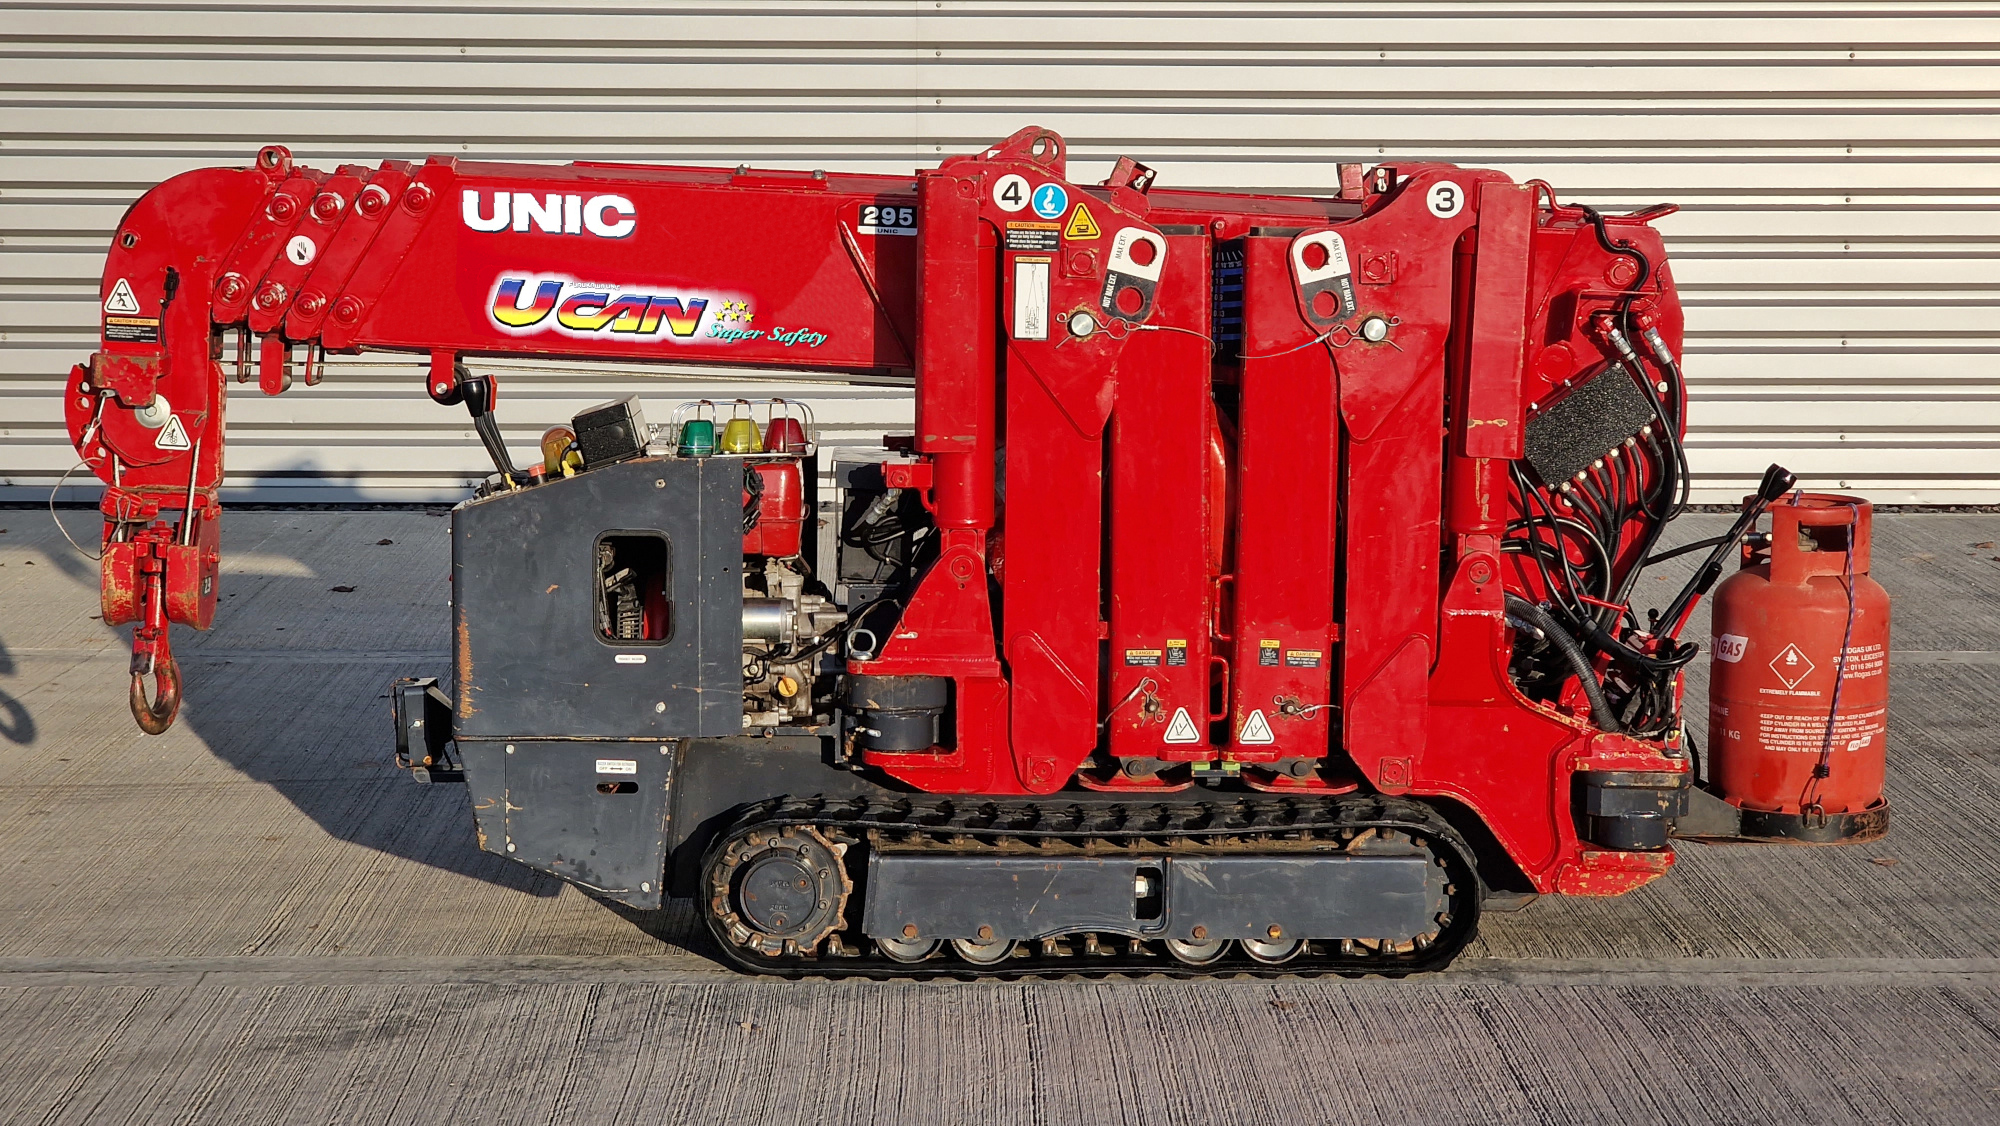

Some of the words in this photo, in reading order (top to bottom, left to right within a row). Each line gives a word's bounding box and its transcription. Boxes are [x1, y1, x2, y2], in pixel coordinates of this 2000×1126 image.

[1001, 181, 1022, 206] 4
[1435, 187, 1455, 212] 3
[462, 190, 637, 240] UNIC
[863, 206, 913, 226] 295
[1331, 238, 1340, 251] MAX
[1115, 247, 1125, 260] MAX
[1105, 283, 1115, 297] MAX
[1341, 278, 1350, 289] NOT
[1343, 289, 1353, 301] MAX
[493, 278, 709, 338] UCAN
[1102, 296, 1112, 308] NOT
[705, 323, 765, 344] Super
[767, 326, 828, 348] Safety
[1720, 640, 1742, 657] GAS
[1865, 644, 1872, 653] UK
[1835, 664, 1849, 672] TL:
[1850, 663, 1865, 671] 0116
[1759, 688, 1788, 696] EXTREMELY
[1728, 729, 1741, 740] KG
